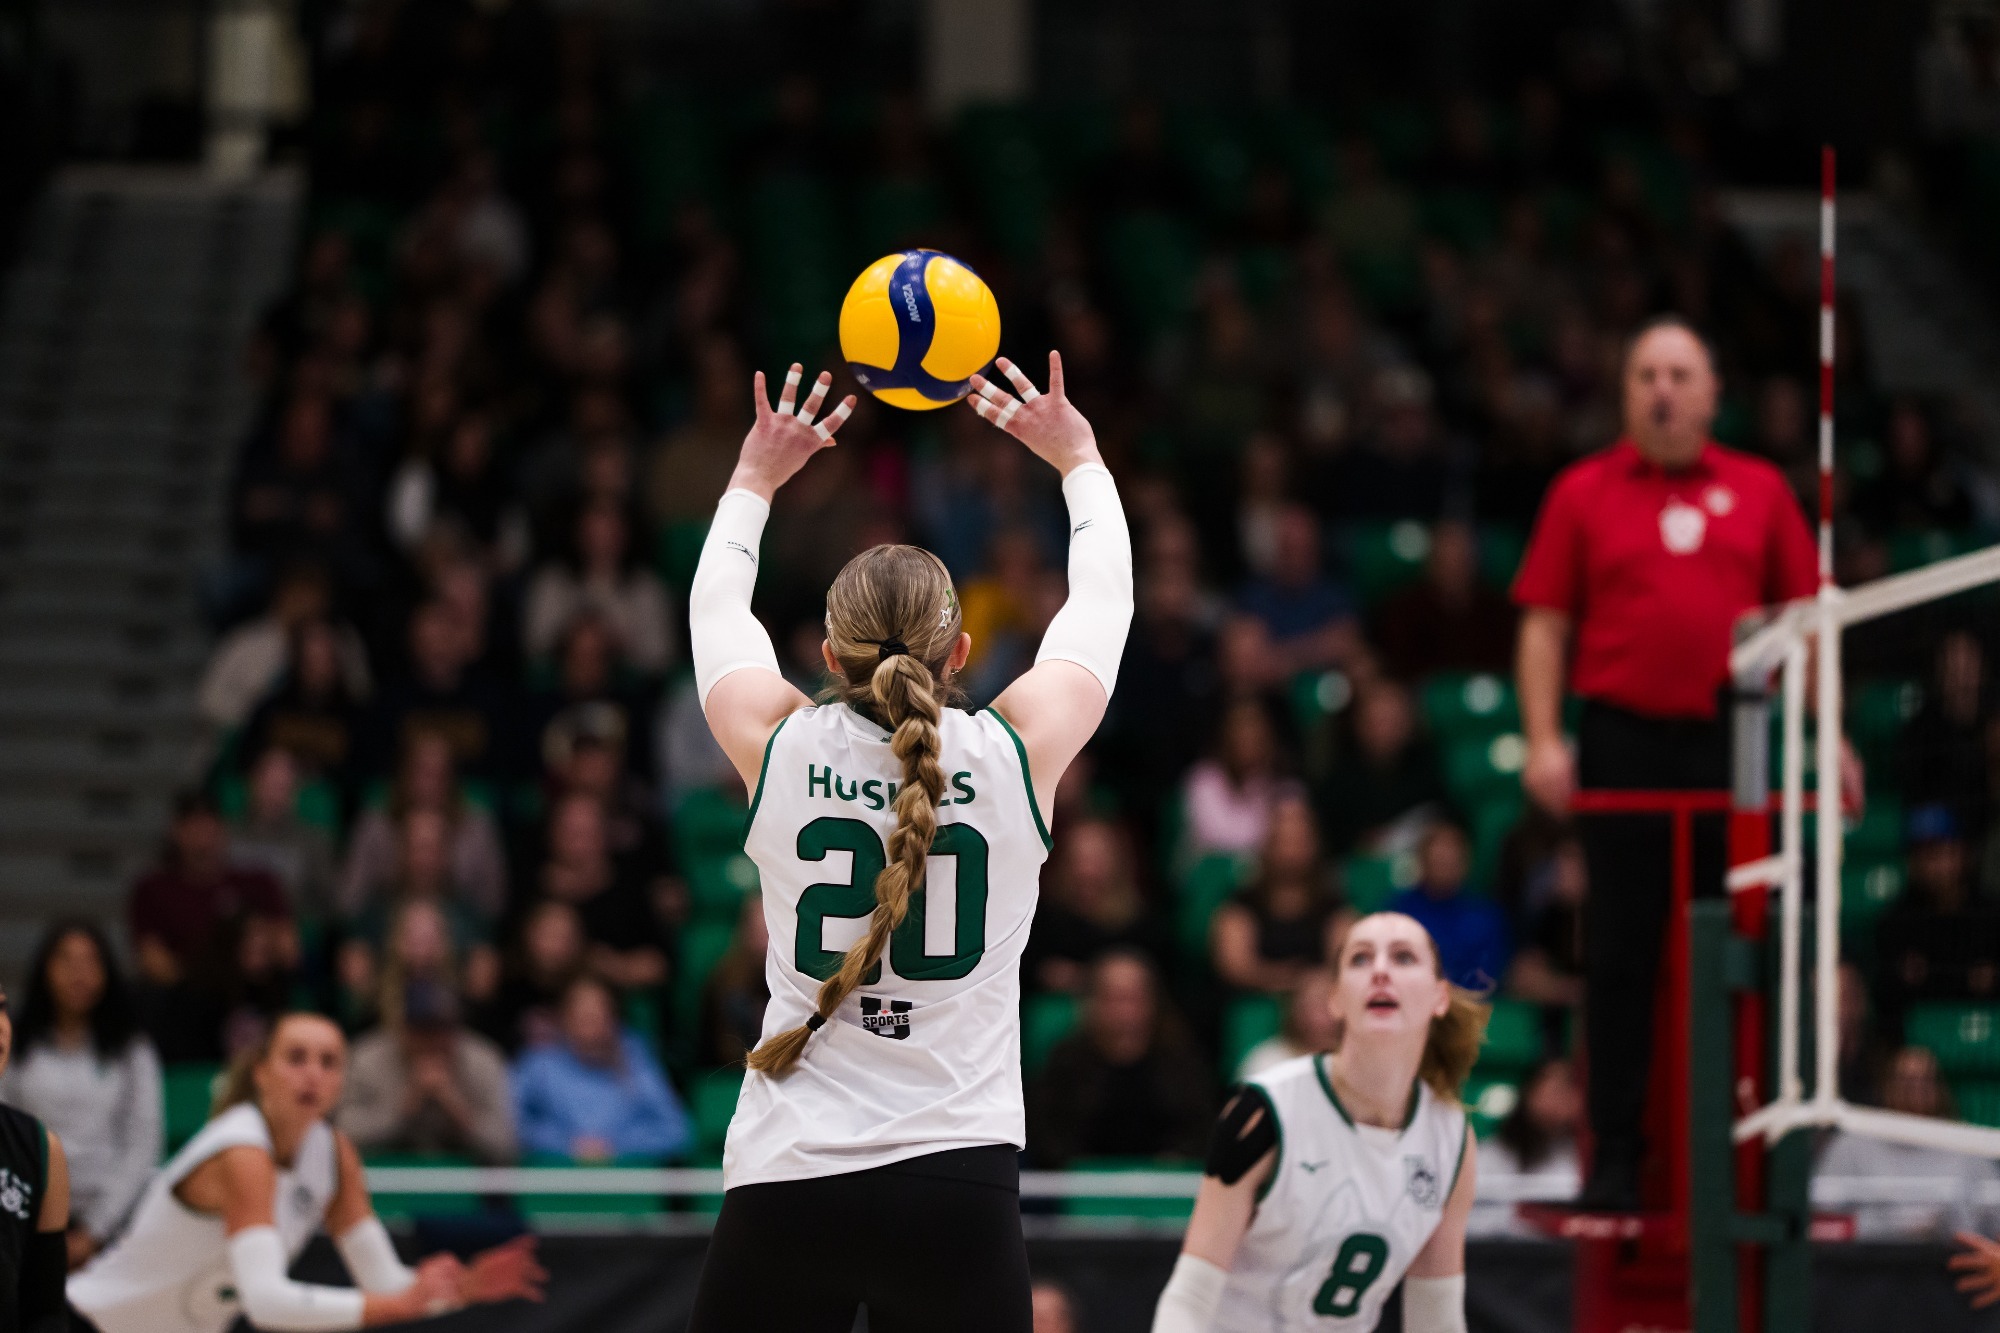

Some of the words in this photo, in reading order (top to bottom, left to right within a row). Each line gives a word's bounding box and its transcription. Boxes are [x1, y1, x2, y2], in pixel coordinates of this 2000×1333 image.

[902, 283, 921, 322] V200W
[795, 816, 988, 985] 20
[862, 1014, 910, 1028] SPORTS
[1313, 1232, 1389, 1318] 8
